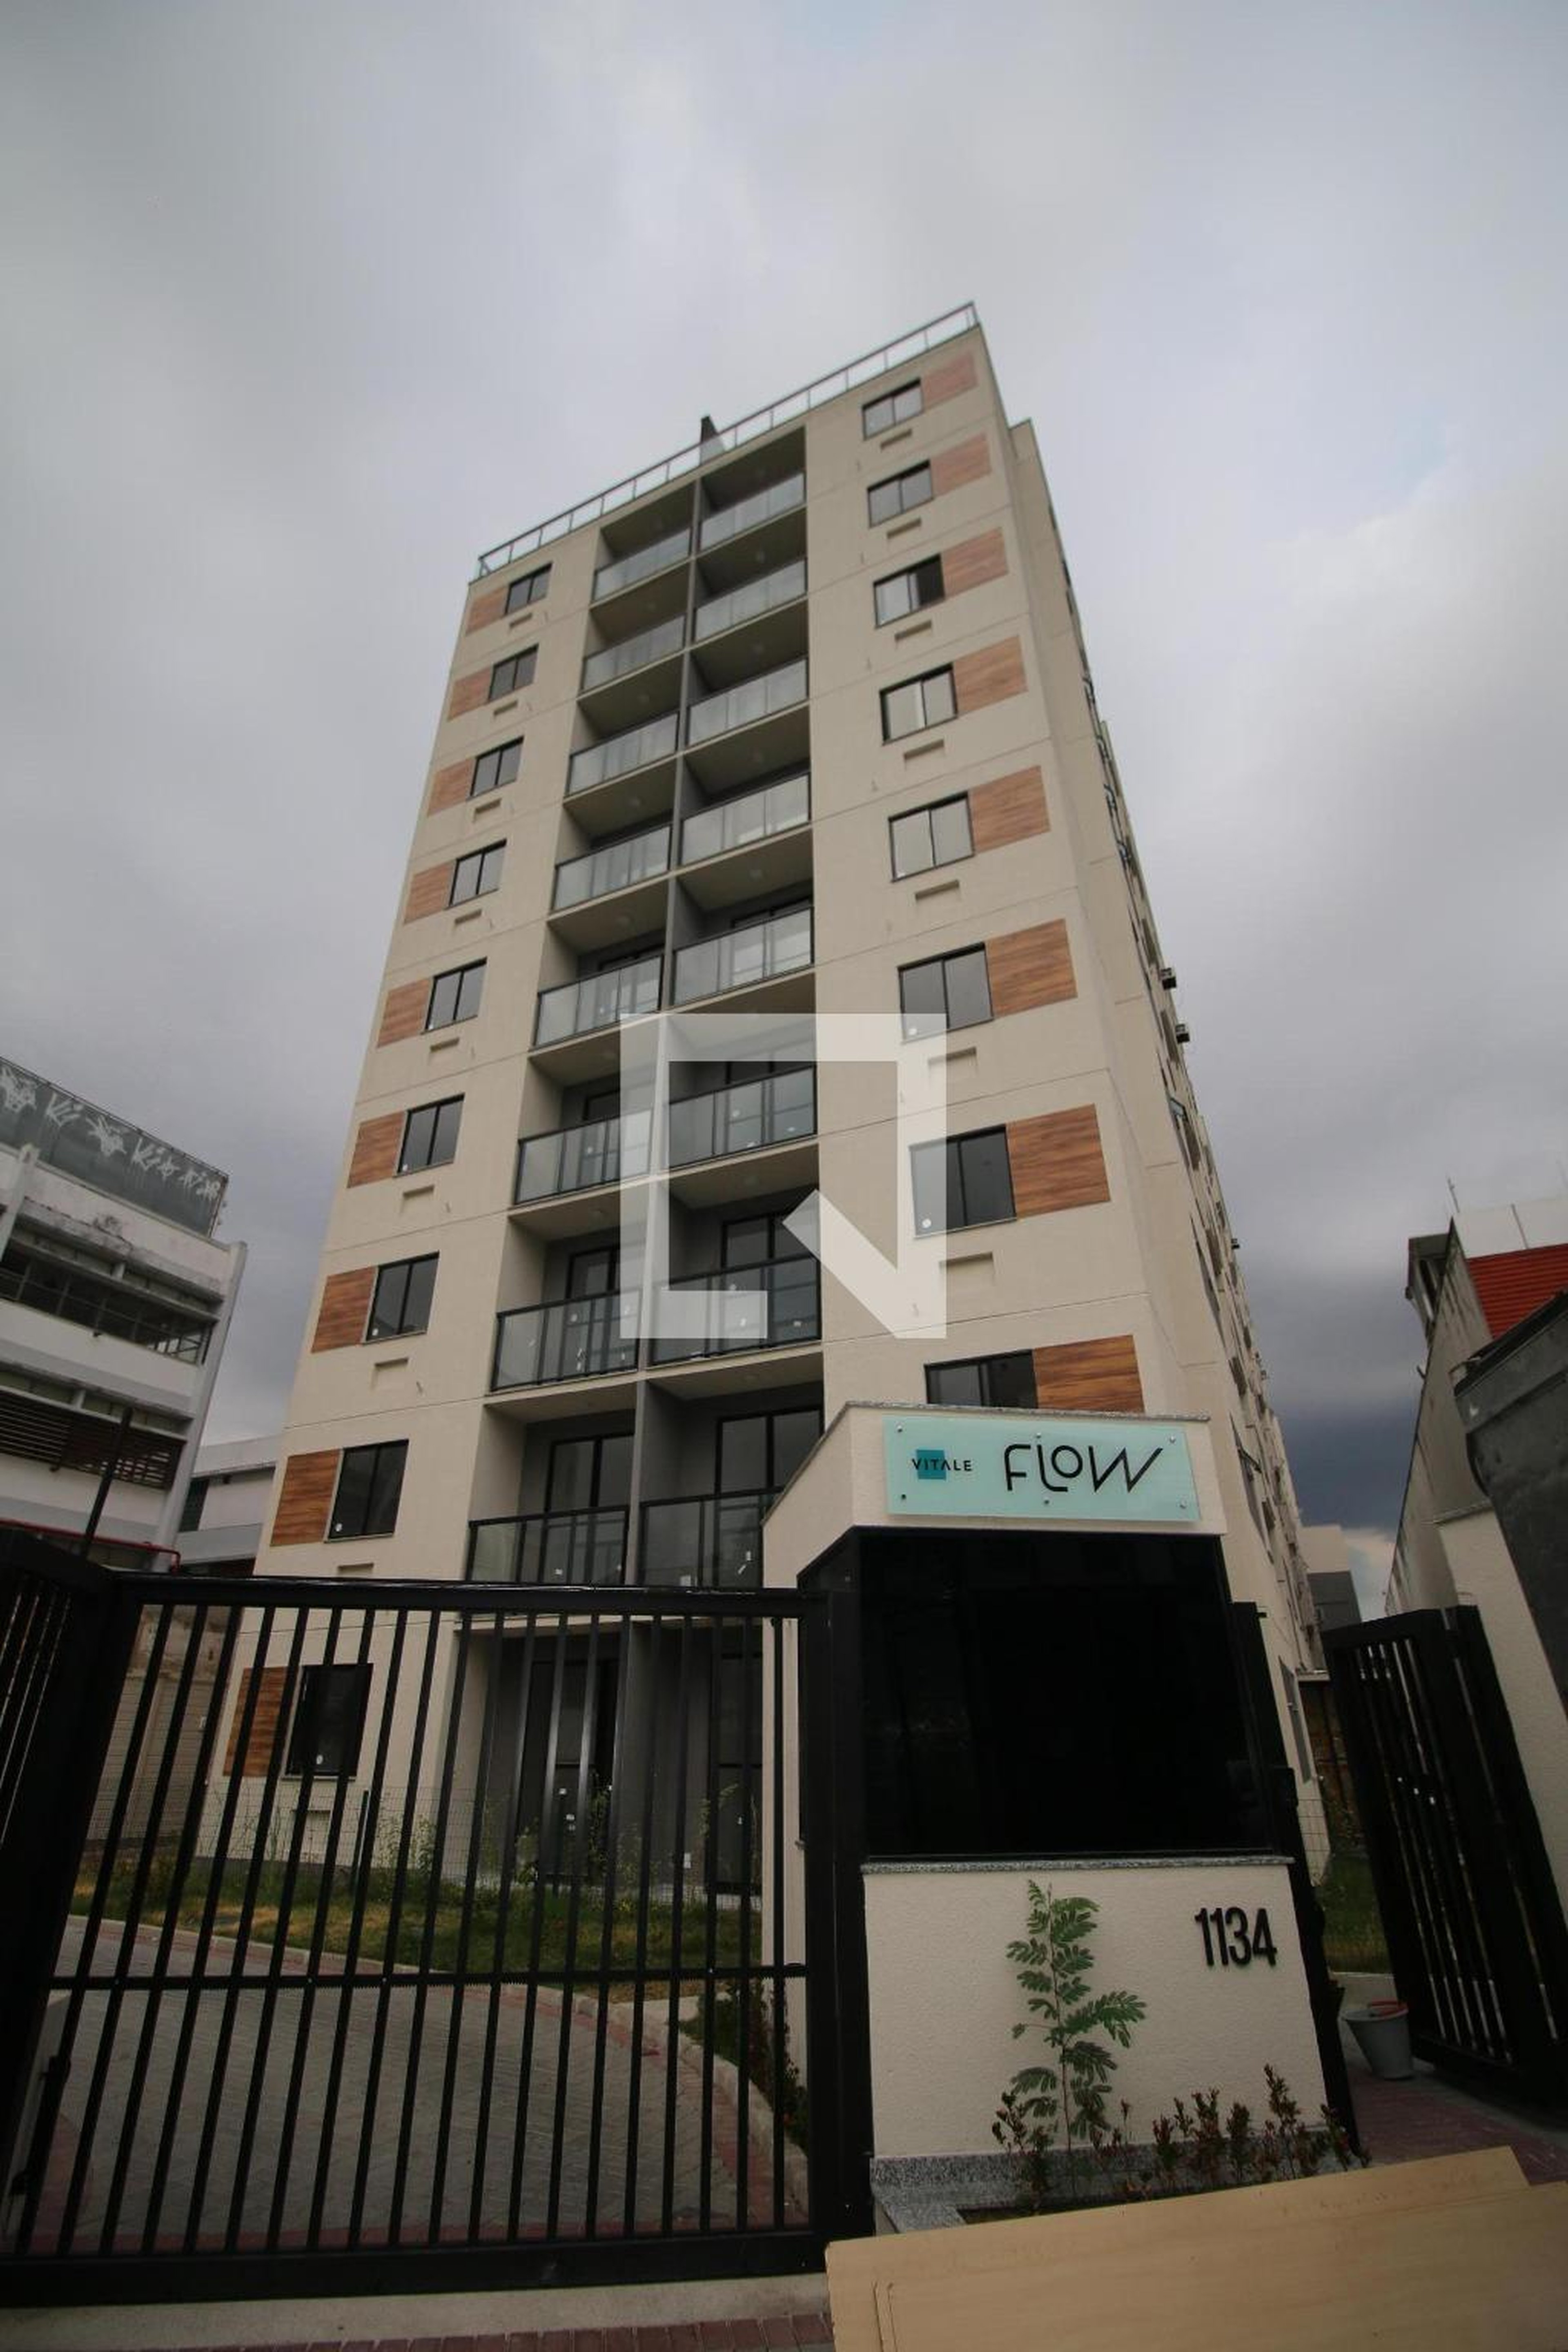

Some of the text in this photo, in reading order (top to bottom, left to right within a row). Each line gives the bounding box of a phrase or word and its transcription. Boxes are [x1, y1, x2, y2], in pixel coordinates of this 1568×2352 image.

[911, 1458, 972, 1471] VITALE
[1004, 1444, 1163, 1492] FLOW
[1194, 1907, 1278, 1967] 1134
